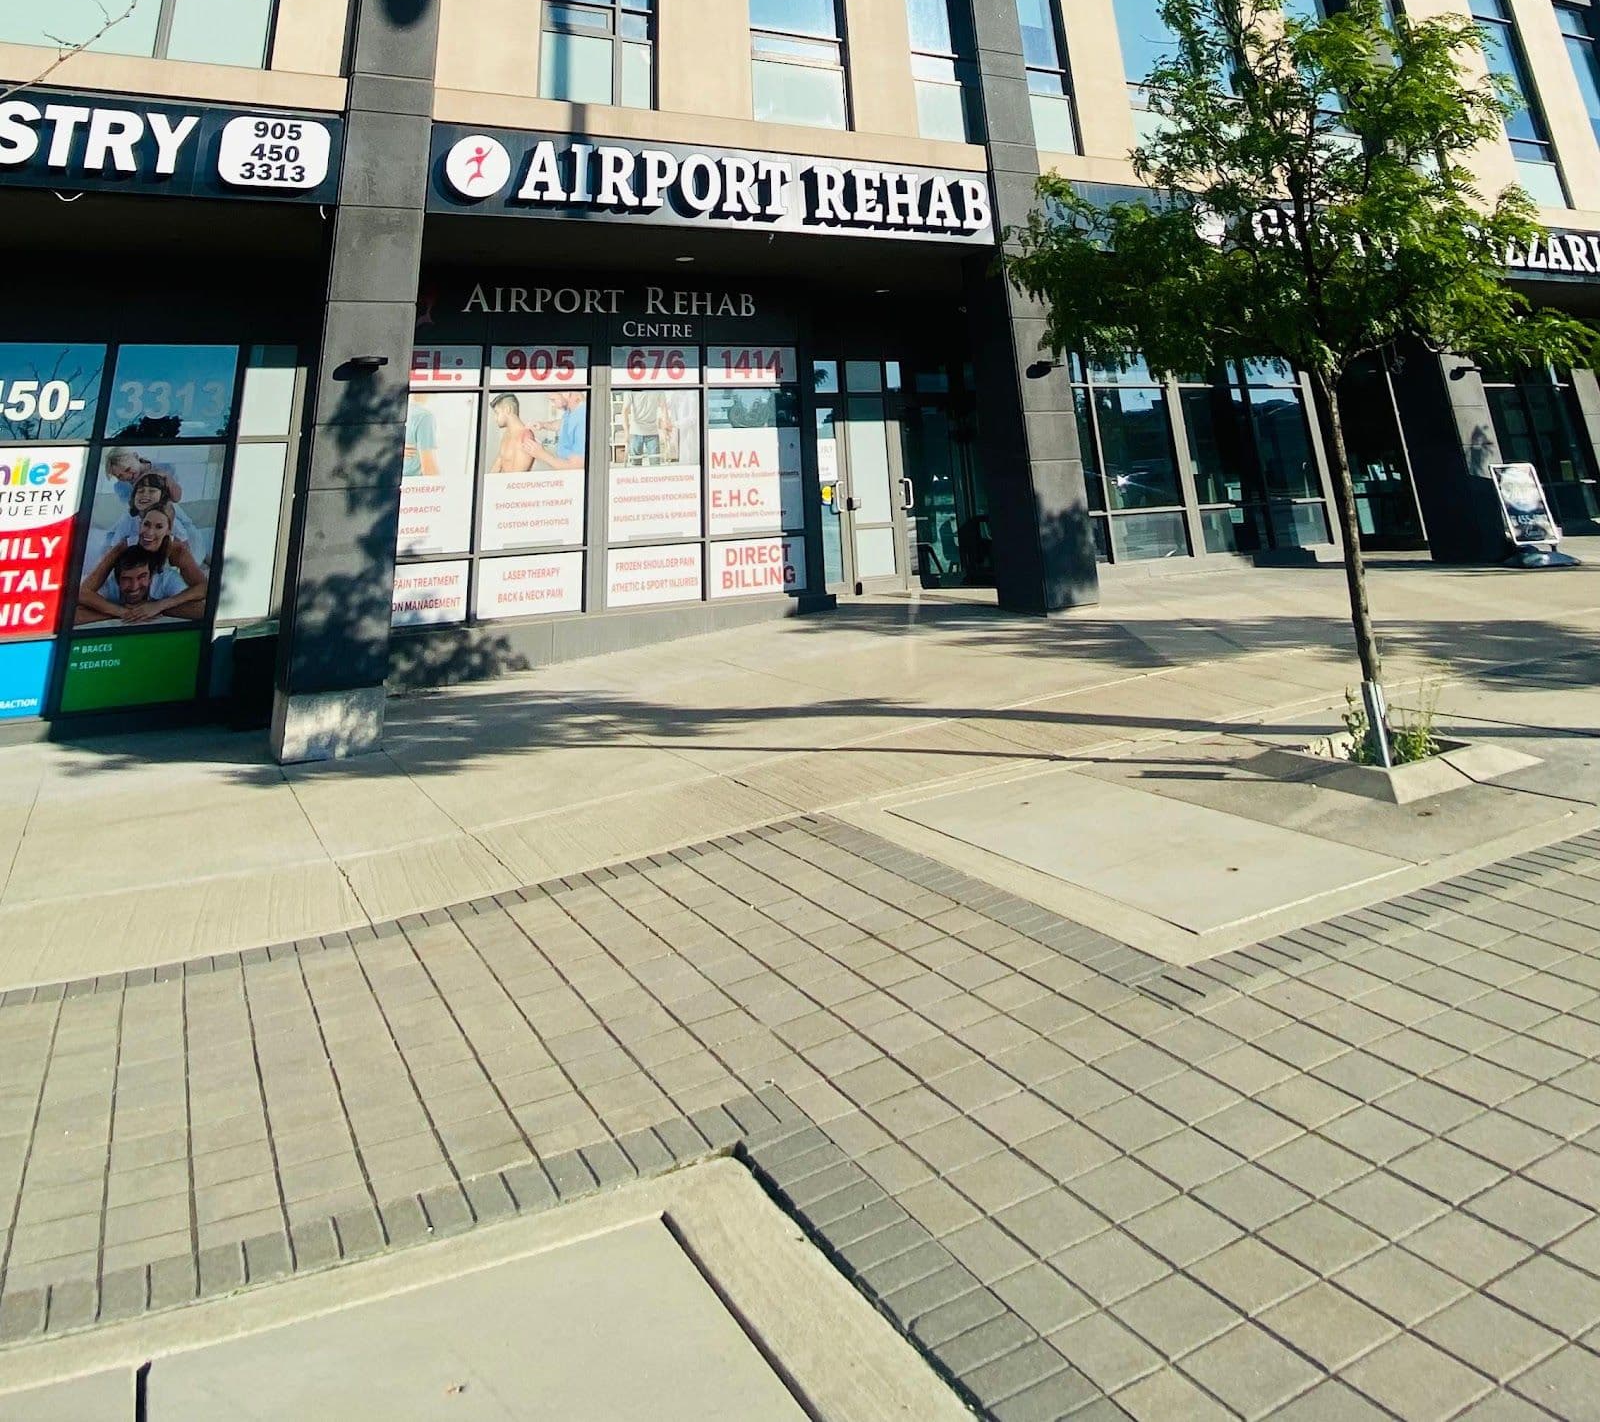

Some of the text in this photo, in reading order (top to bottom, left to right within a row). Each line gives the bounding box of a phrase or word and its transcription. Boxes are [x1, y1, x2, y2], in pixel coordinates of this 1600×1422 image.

[253, 121, 302, 141] 905
[249, 143, 300, 163] 450
[238, 162, 306, 182] 3313
[517, 140, 992, 230] AIRPORT REHAB
[461, 283, 756, 317] AIRPORT REHAB
[622, 321, 693, 338] CENTRE
[505, 349, 576, 382] 905
[626, 349, 686, 380] 676
[720, 349, 784, 380] 1414
[0, 380, 226, 421] 50- 3313
[711, 450, 760, 469] M.V.A
[541, 498, 573, 507] THERAPY
[711, 488, 765, 508] E.H.C.
[0, 504, 64, 517] UEEN
[497, 518, 569, 529] CUSTOM ORTHOTICS
[615, 556, 695, 572] FROZEN SHOULDER PAIN
[725, 544, 792, 567] DIRECT
[0, 568, 62, 593] TAL
[414, 575, 459, 588] TREATMENT
[503, 567, 561, 581] LASER THERAPY
[721, 565, 796, 589] BILLING
[641, 581, 646, 591] &
[646, 579, 669, 590] SPORT
[405, 596, 461, 611] MANAGEMENT
[497, 587, 564, 603] BACK & NECK PAIN
[81, 643, 113, 654] BRACES
[78, 658, 121, 669] SEDATION
